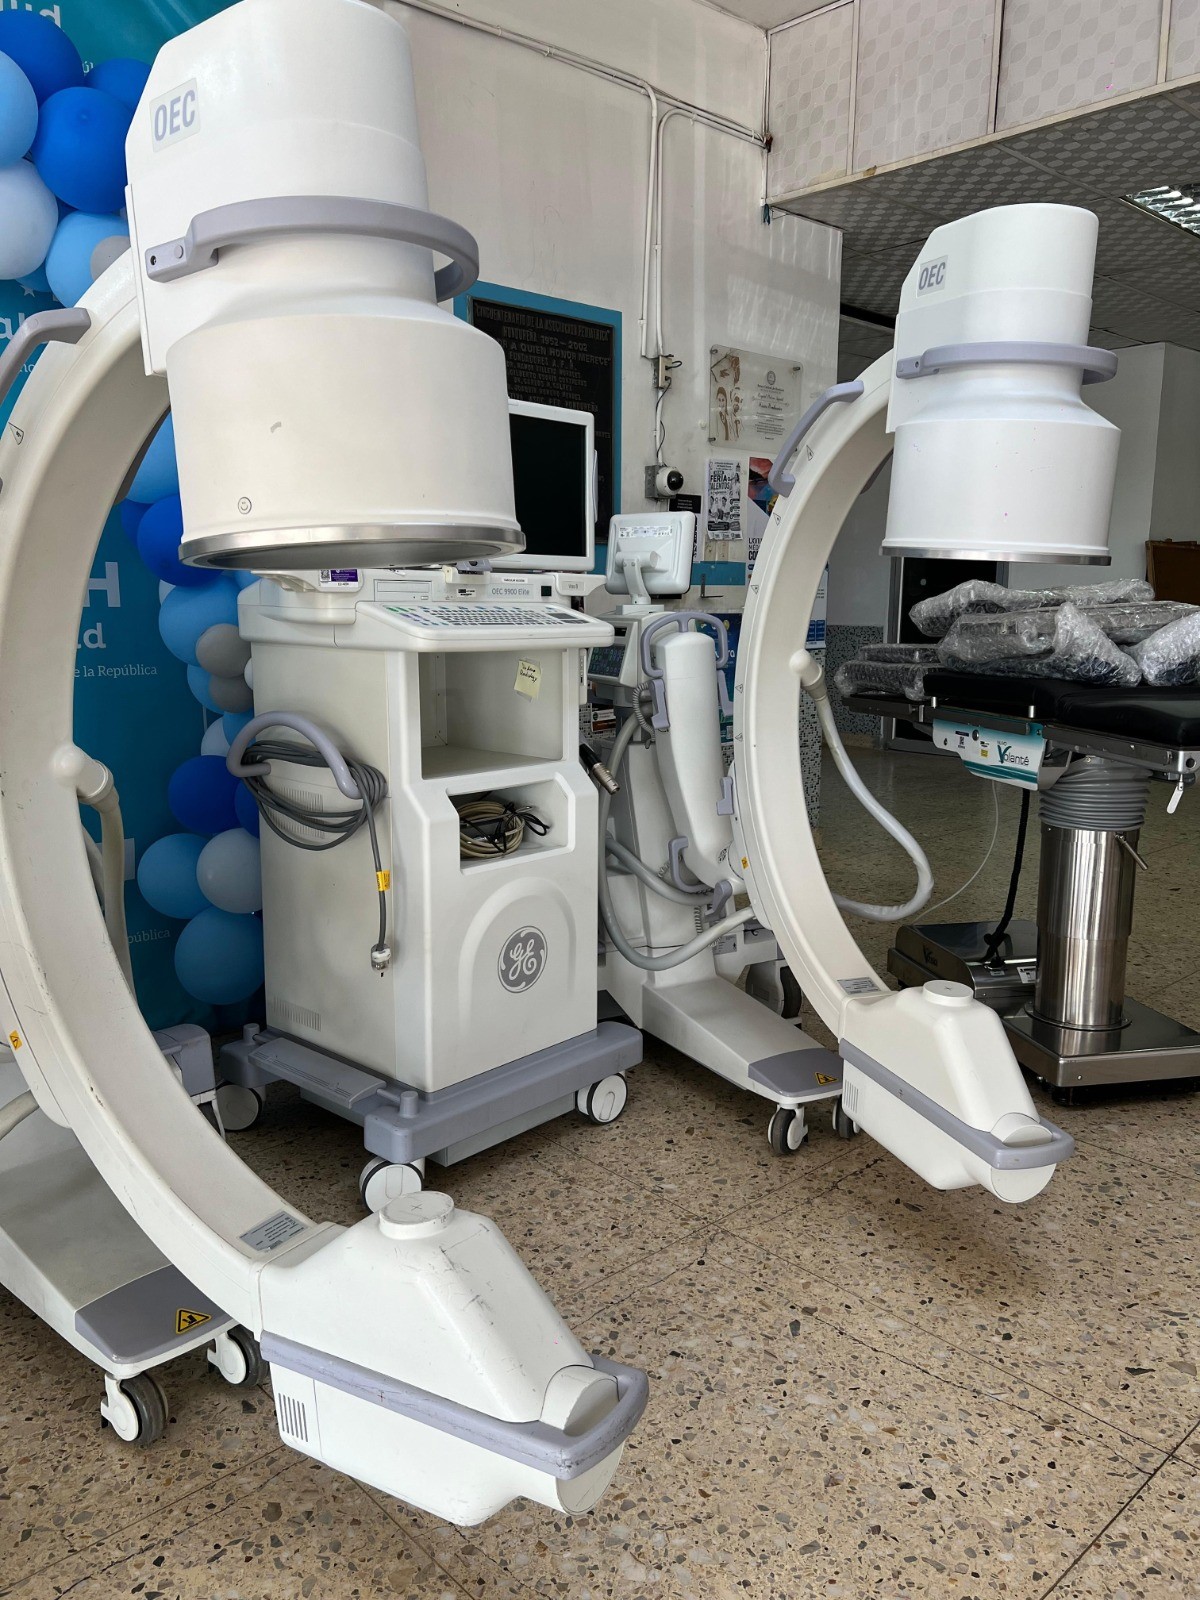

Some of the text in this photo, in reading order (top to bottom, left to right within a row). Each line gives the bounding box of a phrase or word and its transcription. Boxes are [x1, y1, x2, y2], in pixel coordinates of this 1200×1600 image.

[154, 89, 196, 142] OEC
[918, 261, 946, 290] OEC
[510, 342, 517, 350] A
[521, 343, 547, 356] QUIEN
[549, 347, 576, 361] HONOR
[541, 335, 559, 347] 1952
[568, 340, 587, 352] 2002
[83, 666, 95, 677] la
[98, 664, 158, 678] República
[997, 744, 1030, 766] Volanté
